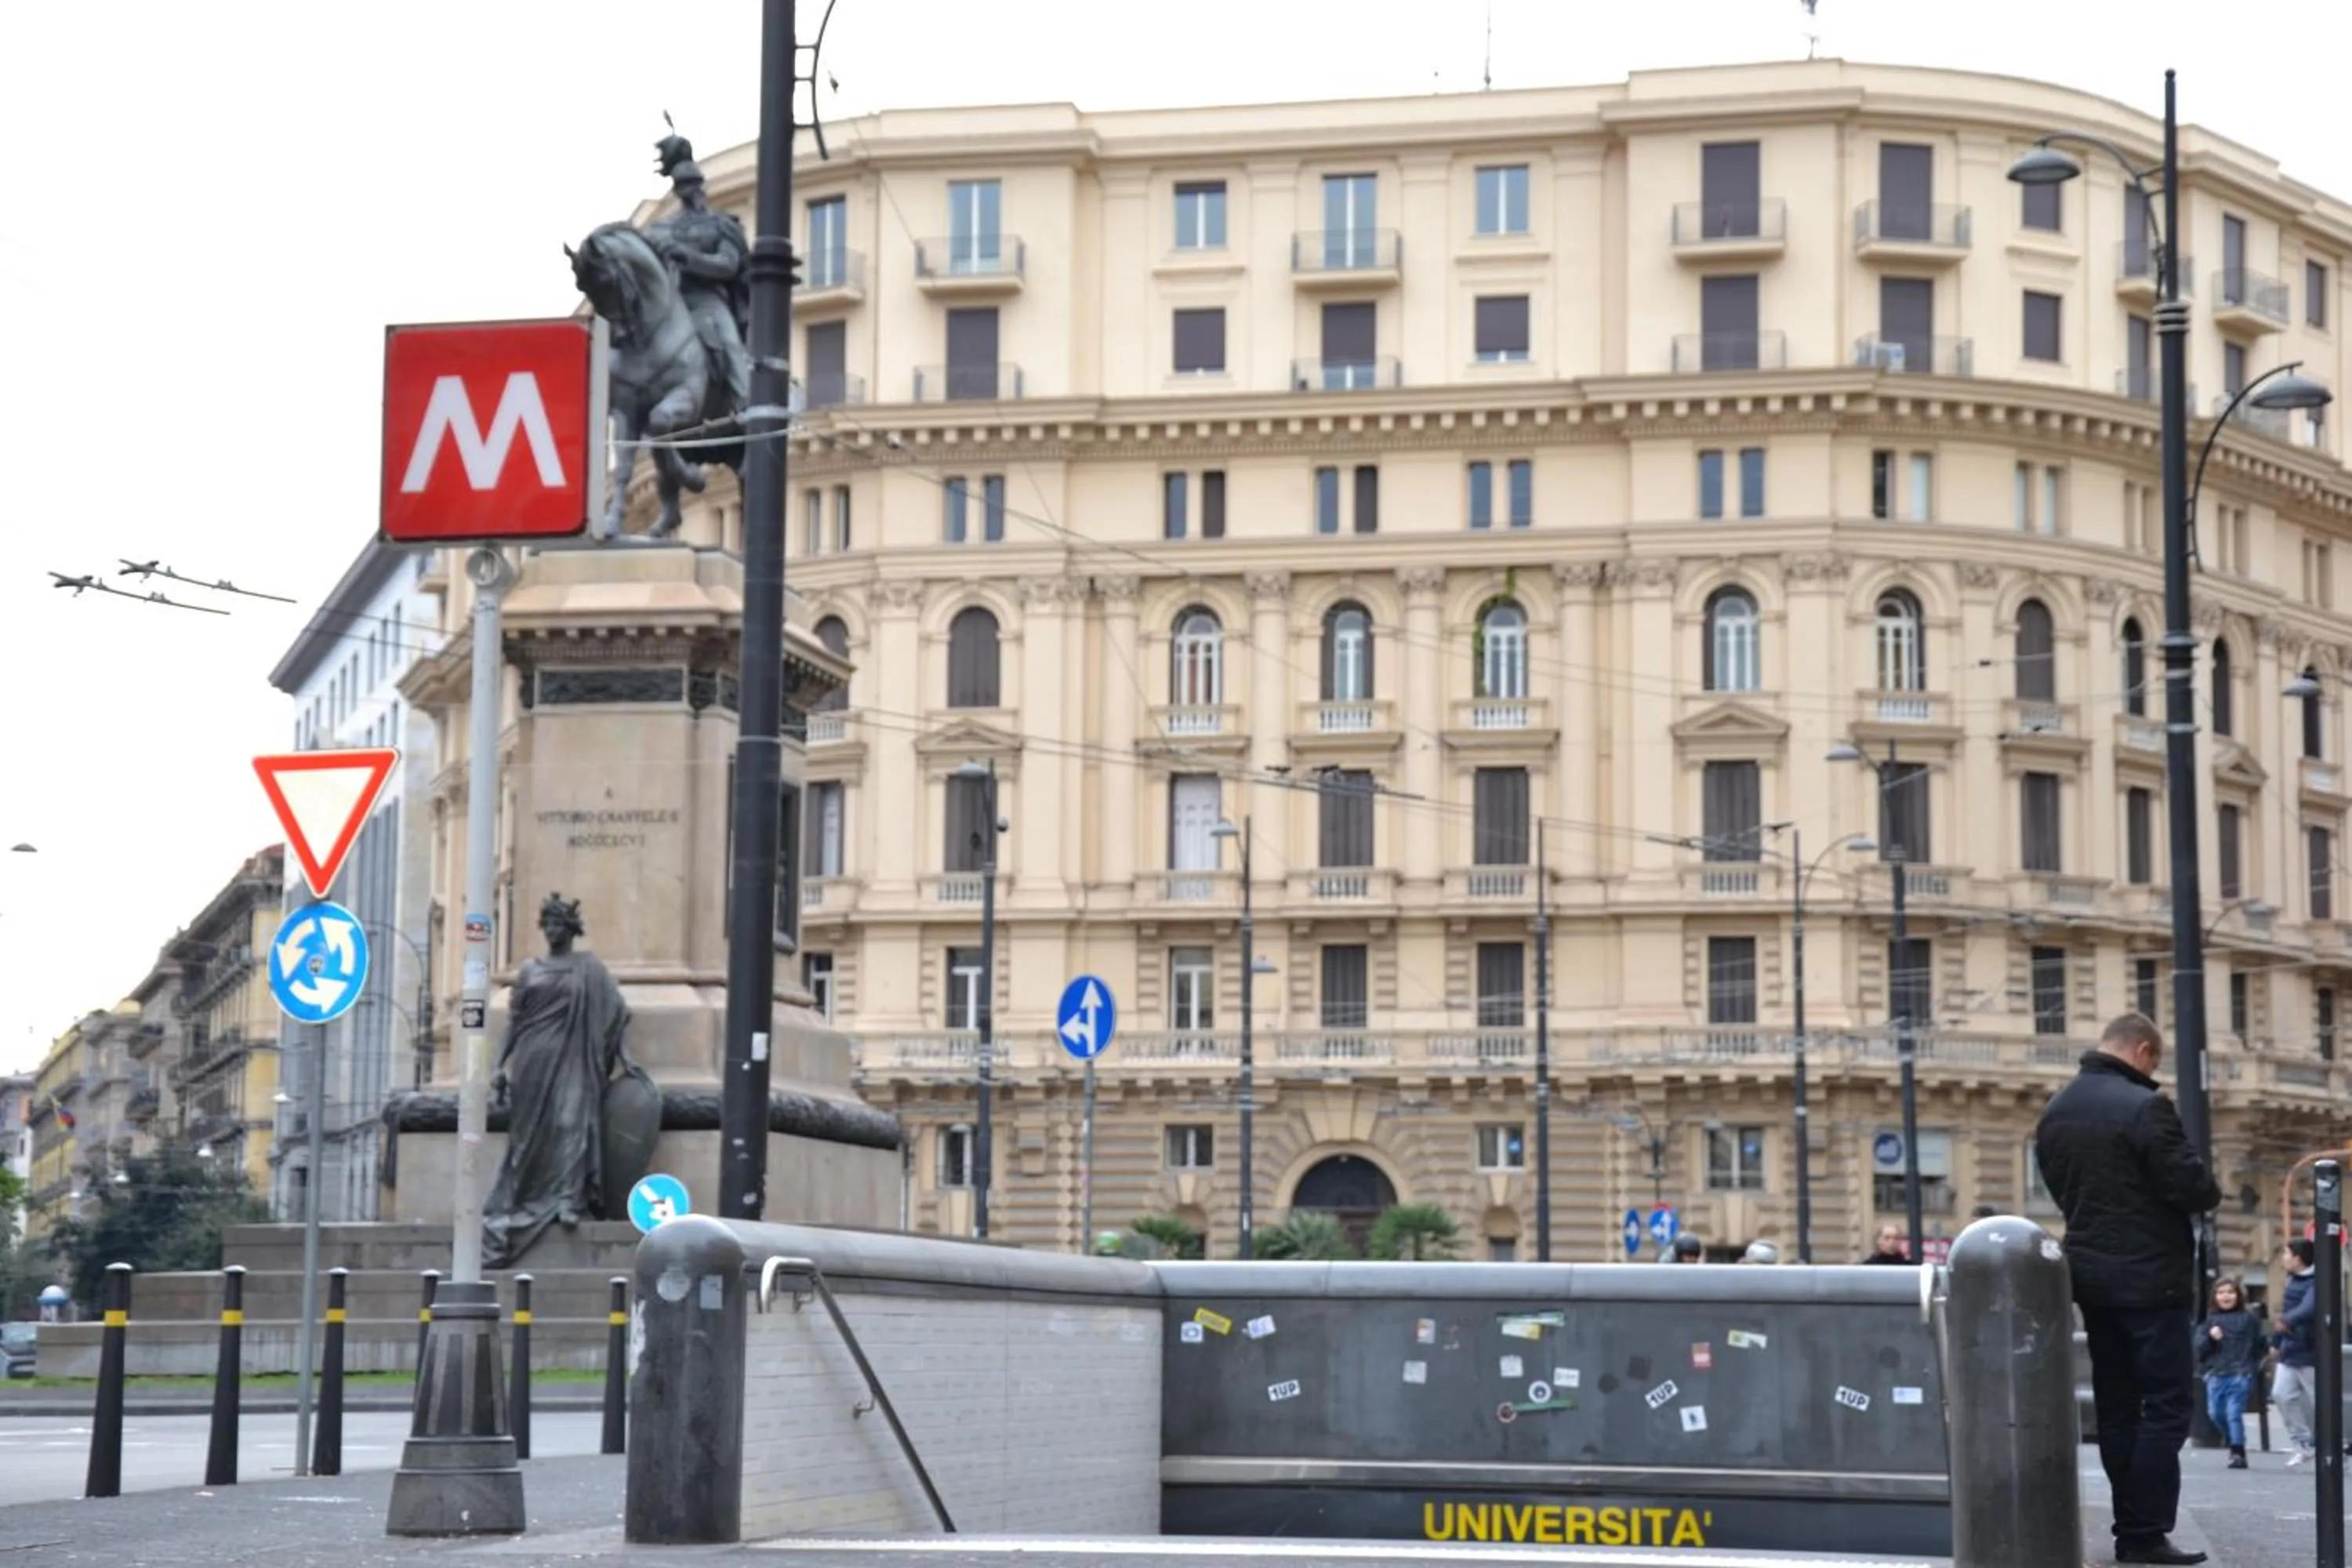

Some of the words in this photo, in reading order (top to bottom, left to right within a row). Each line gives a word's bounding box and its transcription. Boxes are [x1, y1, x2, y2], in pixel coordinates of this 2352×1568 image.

[400, 370, 568, 493] M
[1271, 1381, 1297, 1399] 1UP
[1649, 1382, 1675, 1404] 1UP
[1840, 1390, 1867, 1406] 1UP
[1423, 1502, 1712, 1547] UNIVERSITA'
